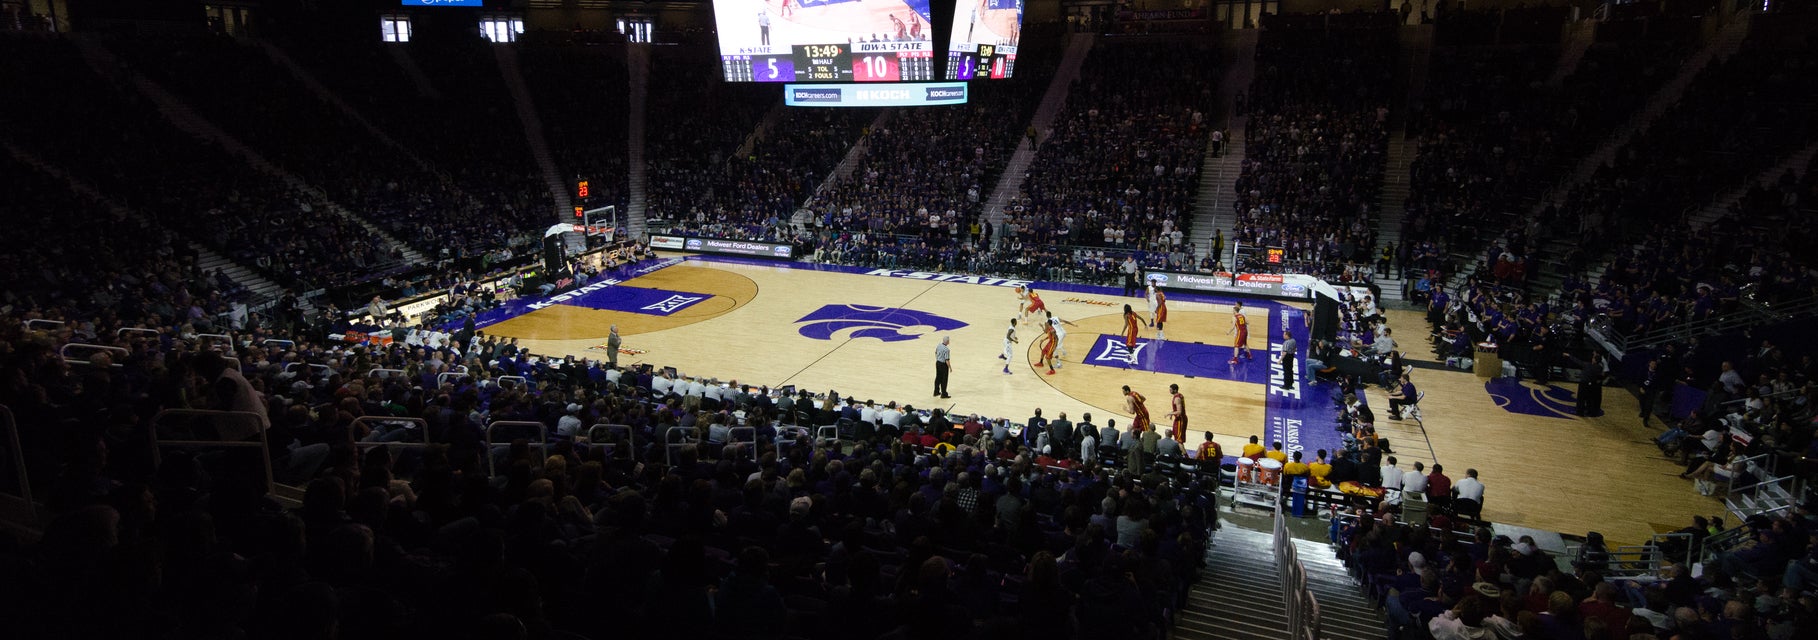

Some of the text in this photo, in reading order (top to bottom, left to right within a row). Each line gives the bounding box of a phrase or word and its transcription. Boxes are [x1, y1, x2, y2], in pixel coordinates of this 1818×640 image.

[739, 46, 771, 54] K-STATE
[804, 45, 838, 57] 13:49
[861, 42, 922, 51] IOWA STATE
[768, 58, 778, 78] 5
[863, 56, 887, 78] 10
[963, 56, 970, 76] 5
[995, 57, 1003, 76] 10
[870, 90, 910, 100] KOCH
[579, 187, 588, 197] 23
[707, 240, 731, 248] Midwest
[747, 243, 769, 251] Dealers
[1269, 254, 1279, 263] 23
[865, 268, 1033, 288] K-STATE
[1177, 275, 1214, 285] Midwest
[1238, 280, 1272, 289] Dealers
[526, 278, 622, 310] K-STATE
[1207, 447, 1216, 457] 15
